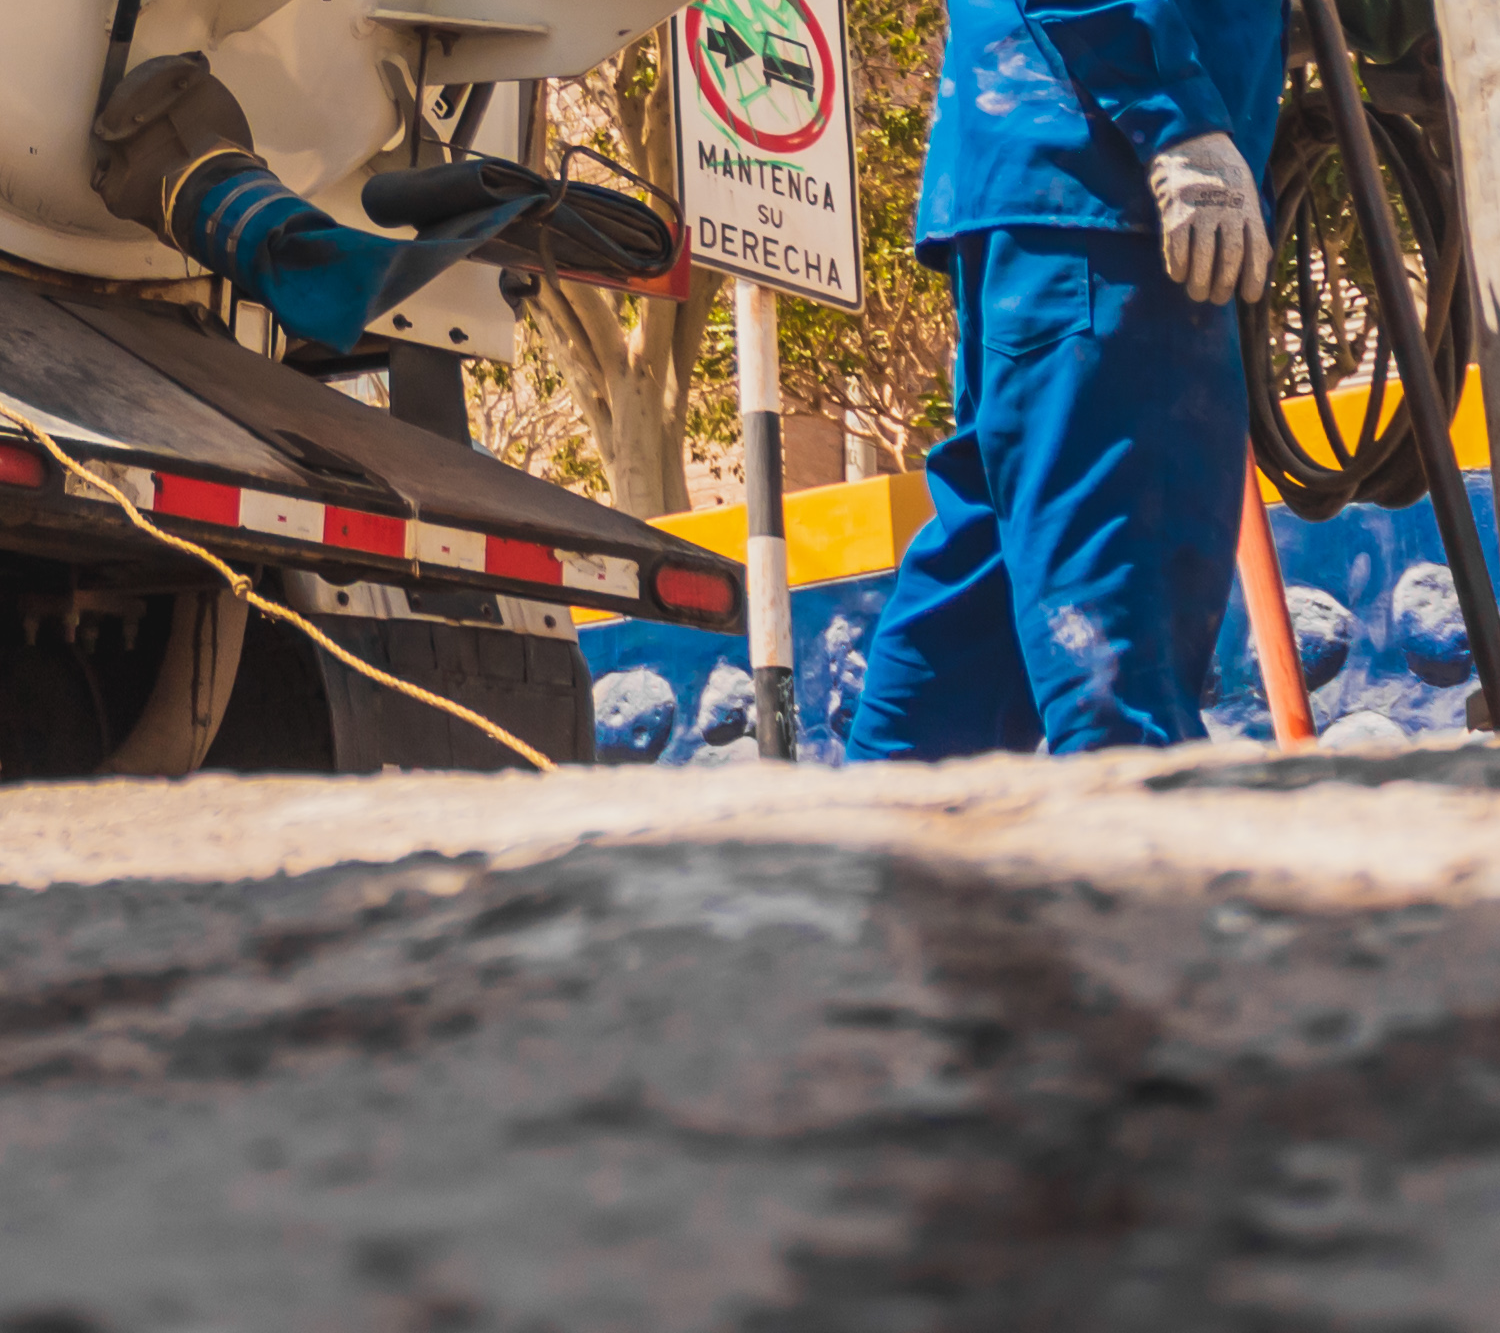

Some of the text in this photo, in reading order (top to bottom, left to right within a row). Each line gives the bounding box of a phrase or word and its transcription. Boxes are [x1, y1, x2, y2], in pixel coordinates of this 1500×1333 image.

[698, 139, 835, 213] MANTENGA
[699, 216, 842, 290] DERECHA
[758, 204, 783, 229] SU
